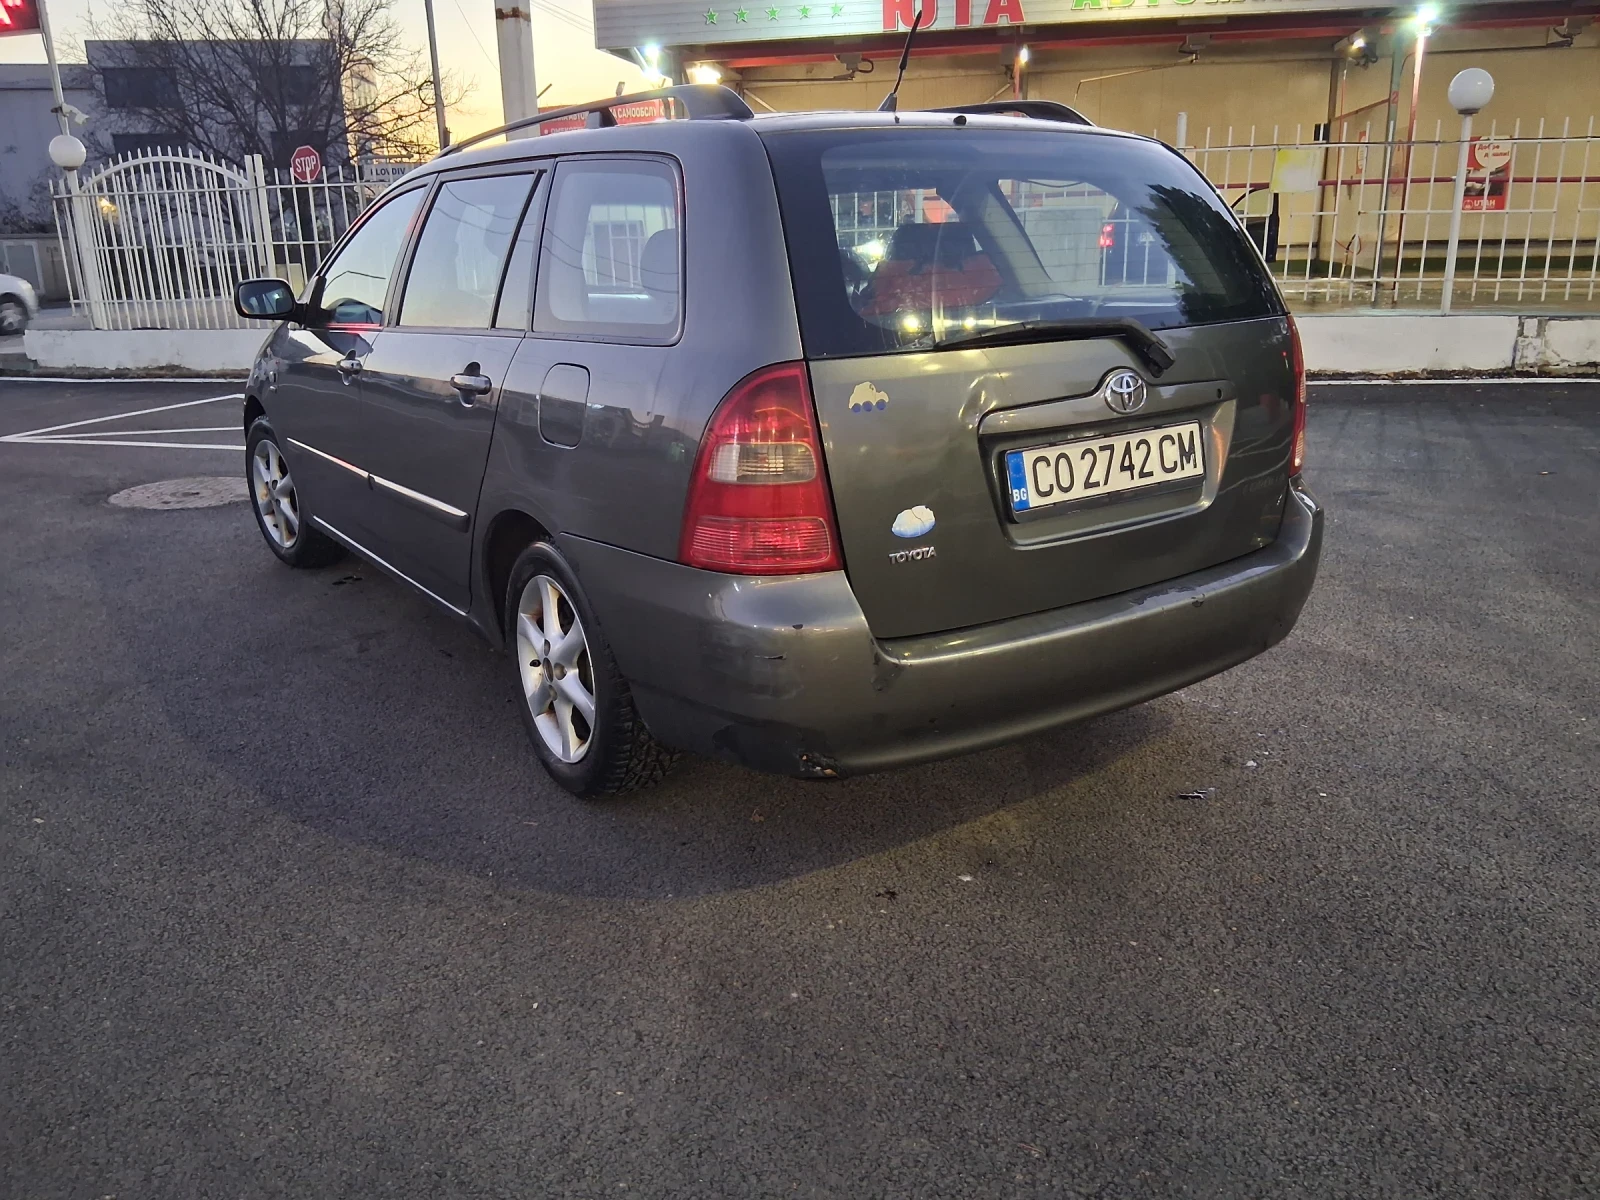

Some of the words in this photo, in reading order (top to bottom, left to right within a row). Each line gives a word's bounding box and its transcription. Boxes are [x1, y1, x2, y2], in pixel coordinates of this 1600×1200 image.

[295, 155, 317, 173] STOP
[1032, 452, 1075, 498] CO
[1080, 438, 1154, 490] 2742
[1158, 430, 1198, 474] CM
[1013, 487, 1028, 502] BG
[888, 545, 937, 565] TOYOTA
